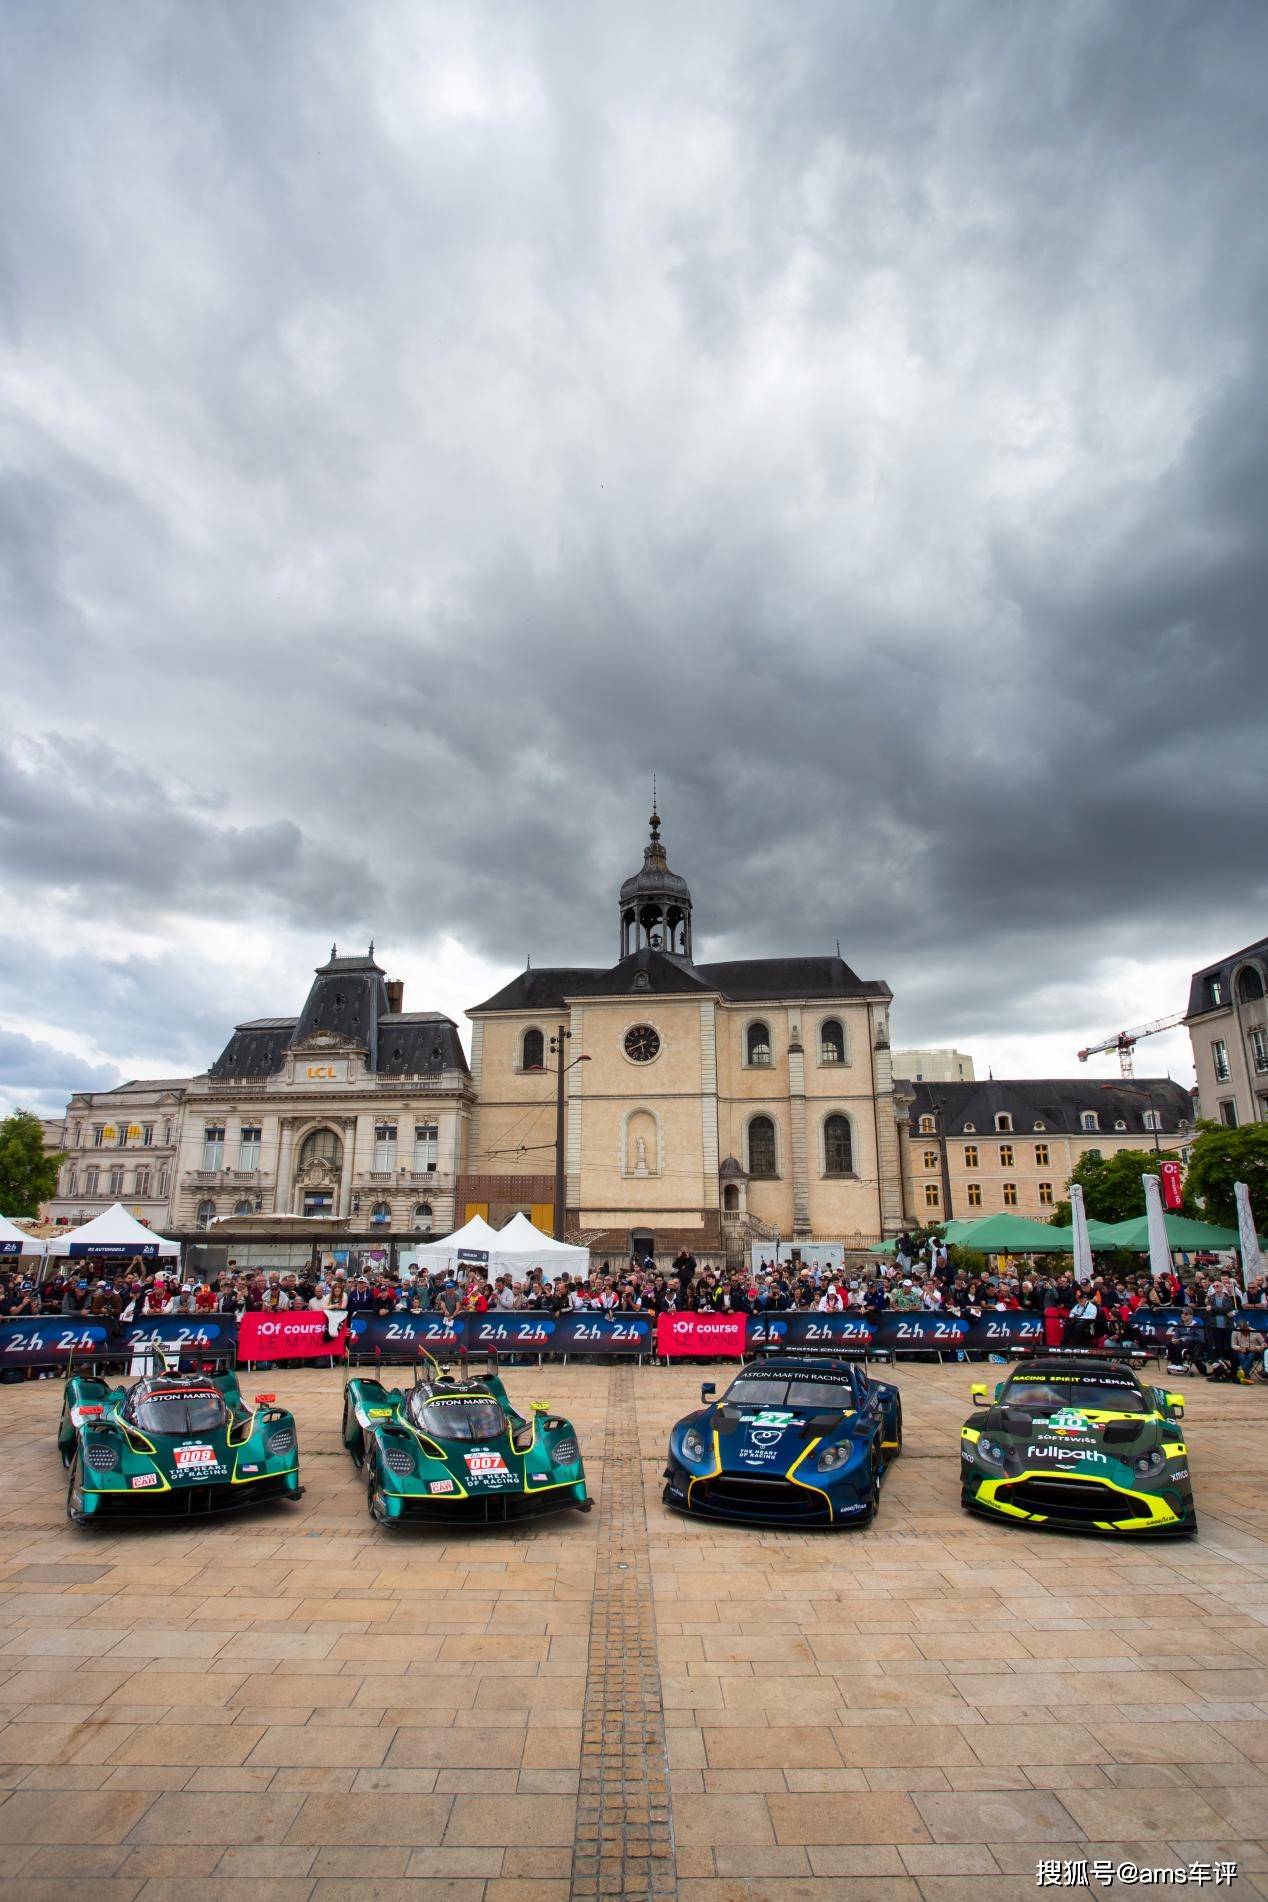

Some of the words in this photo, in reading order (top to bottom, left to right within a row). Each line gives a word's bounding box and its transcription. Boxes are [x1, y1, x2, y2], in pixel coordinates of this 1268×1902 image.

[306, 1064, 336, 1080] LCL
[697, 1324, 738, 1333] course
[699, 1334, 739, 1346] MANS
[811, 1374, 848, 1382] RACING
[146, 1394, 181, 1402] ASTON
[428, 1400, 460, 1408] ASTON
[758, 1414, 790, 1424] 27
[1056, 1418, 1082, 1426] 10
[180, 1451, 210, 1462] 009
[1028, 1446, 1106, 1464] fullpath
[470, 1458, 500, 1469] 007
[134, 1478, 155, 1487] CAR
[433, 1484, 452, 1492] CAR
